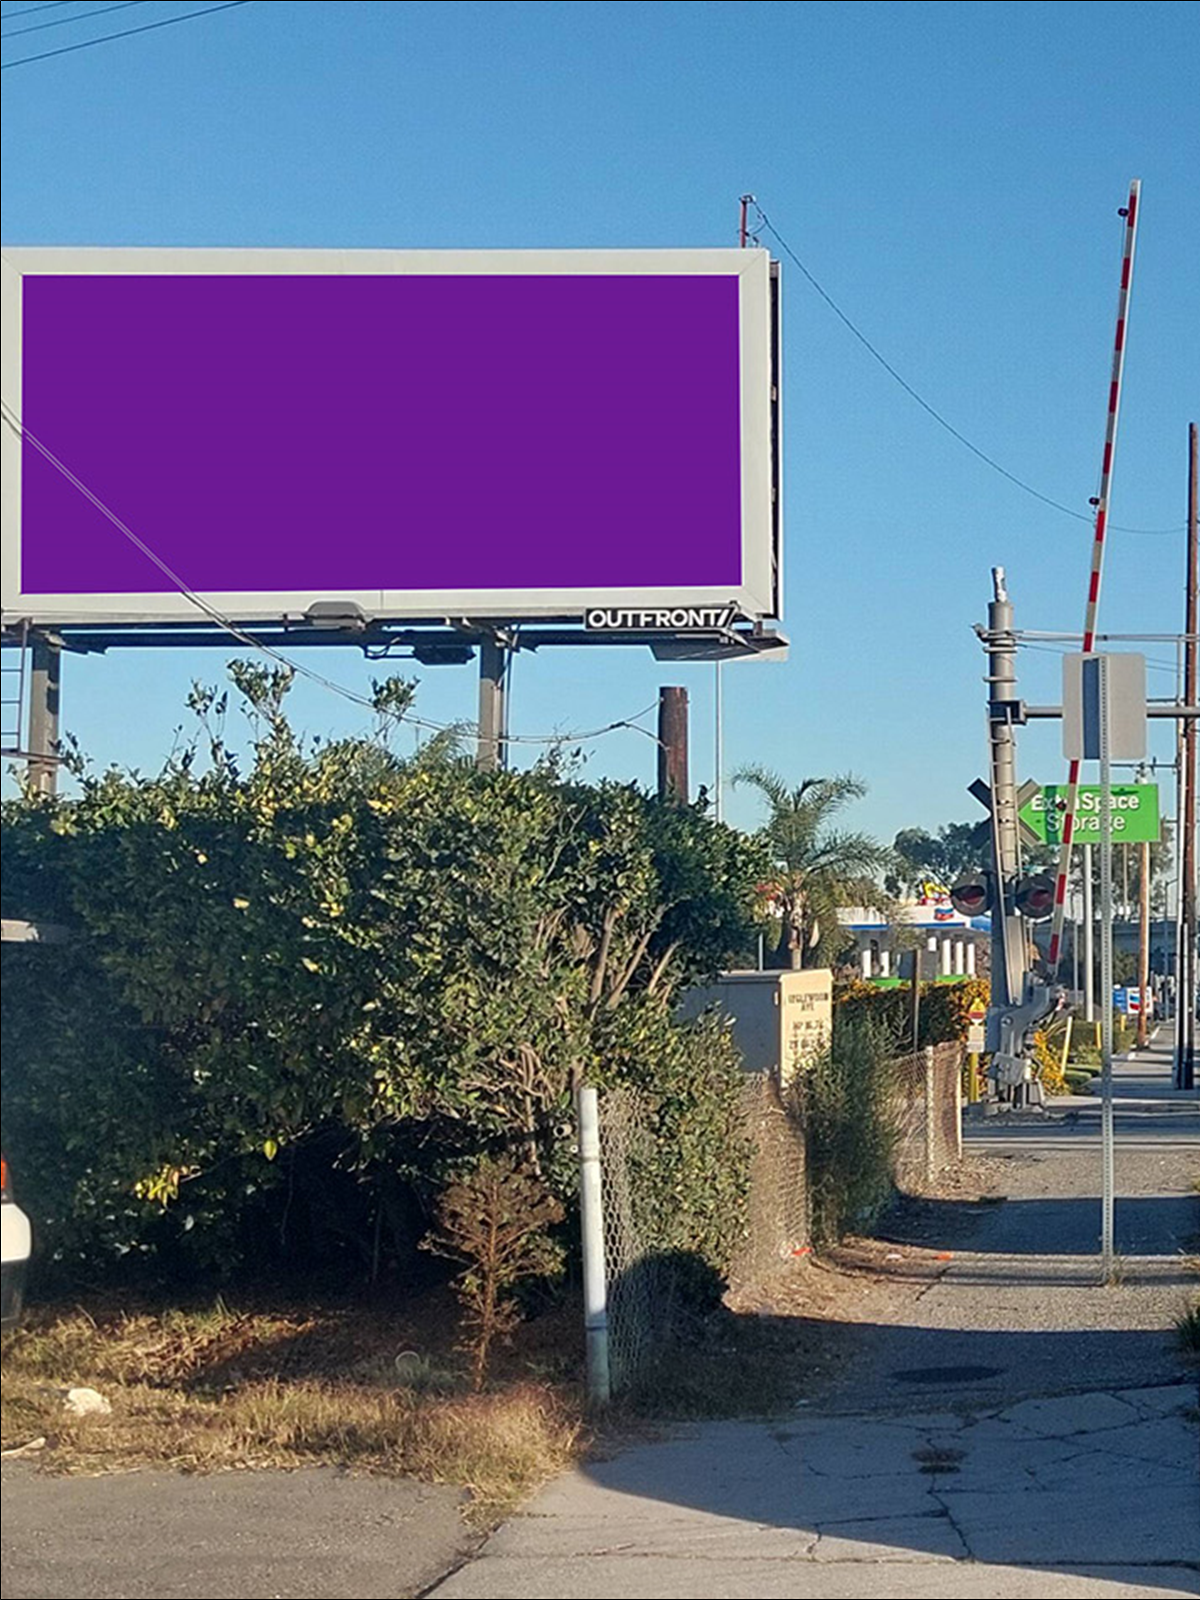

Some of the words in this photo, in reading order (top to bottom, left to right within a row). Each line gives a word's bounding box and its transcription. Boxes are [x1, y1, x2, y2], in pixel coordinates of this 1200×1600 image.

[1031, 793, 1080, 812] Ext
[1082, 793, 1140, 814] Space
[1047, 813, 1126, 833] Sorae
